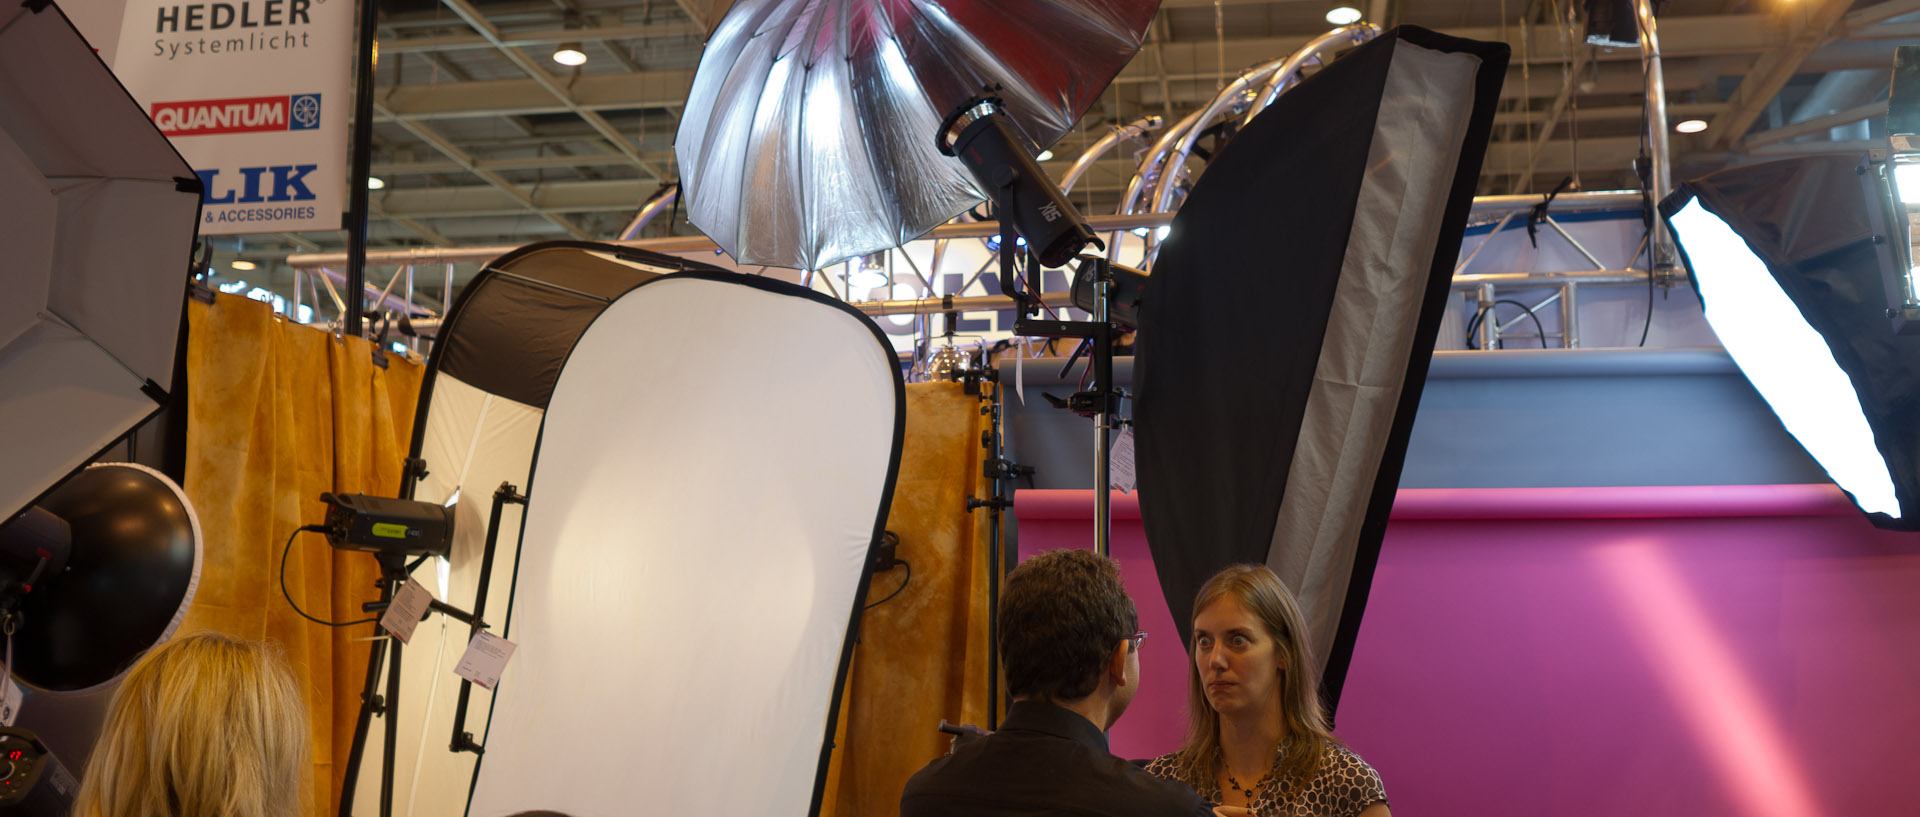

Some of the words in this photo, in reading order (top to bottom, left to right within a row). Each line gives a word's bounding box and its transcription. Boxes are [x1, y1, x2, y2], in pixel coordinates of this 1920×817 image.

[156, 0, 311, 33] HEDLER
[154, 31, 310, 60] Systemlicht
[155, 102, 284, 131] QUANTUM
[205, 211, 214, 223] &
[218, 206, 315, 222] ACCESSORIES
